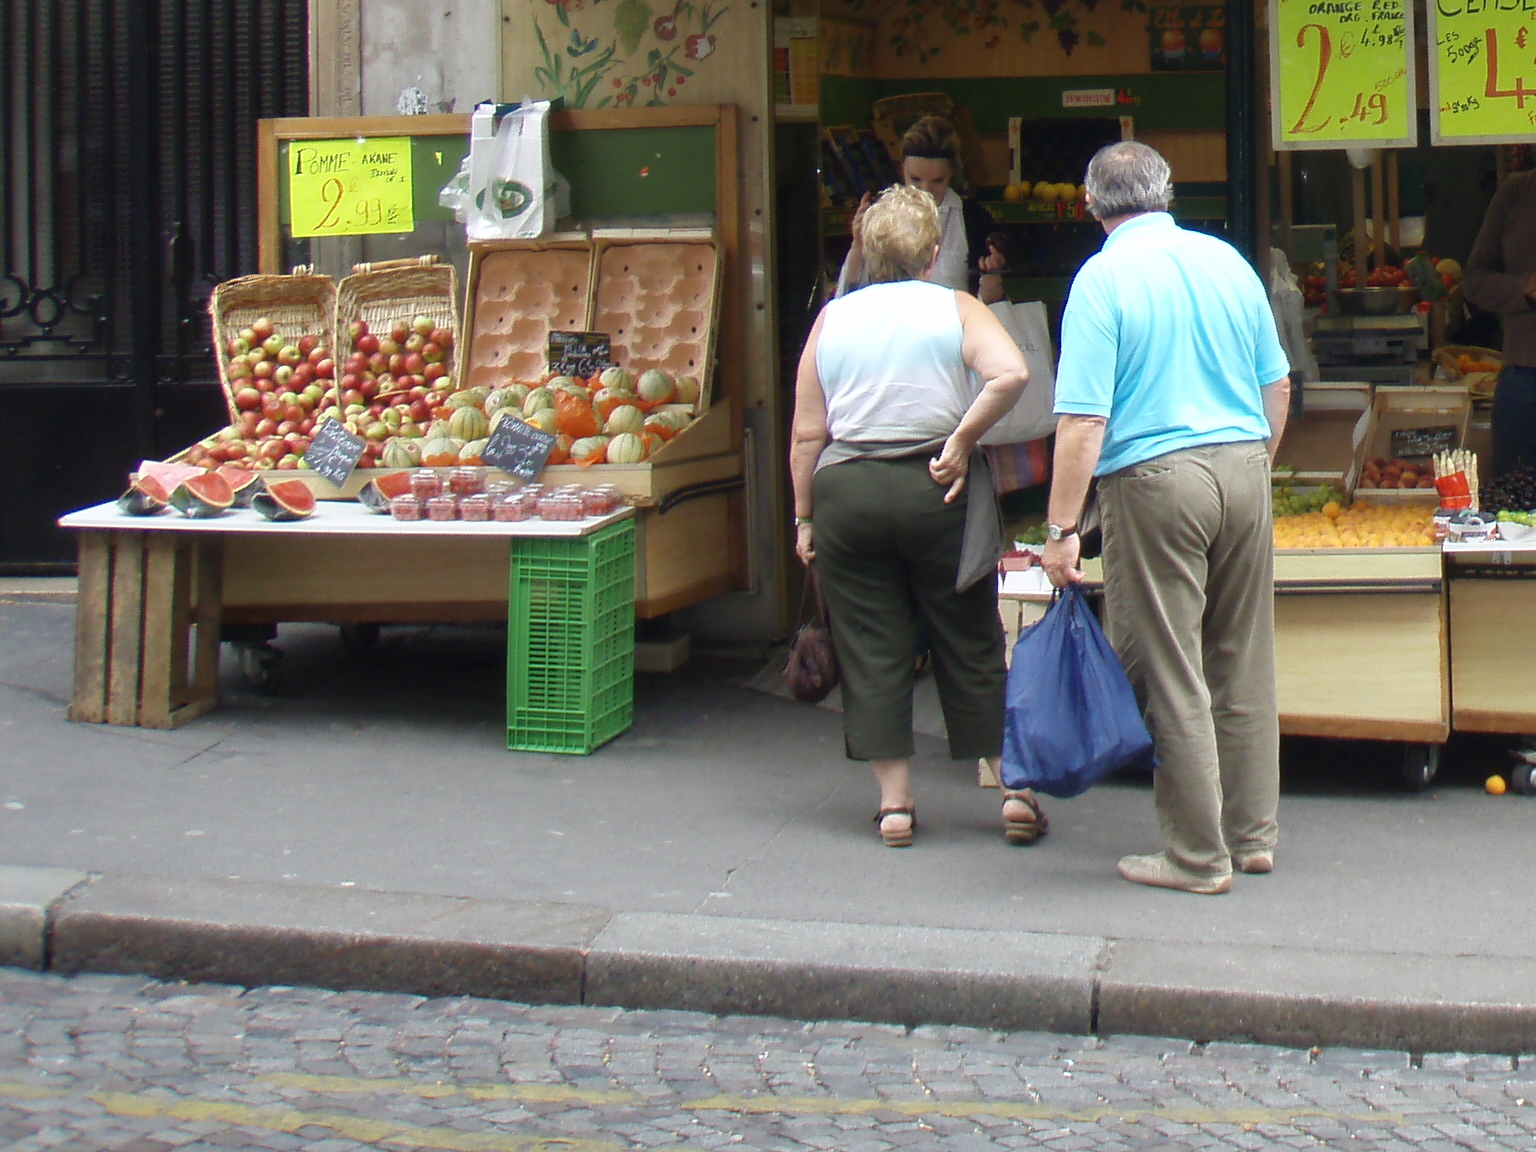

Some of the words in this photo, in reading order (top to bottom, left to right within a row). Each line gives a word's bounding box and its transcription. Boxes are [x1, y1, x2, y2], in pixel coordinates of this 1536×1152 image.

[1309, 1, 1362, 15] ORANGE
[1514, 25, 1529, 49] €
[295, 147, 351, 176] POMME
[361, 152, 398, 165] AKANE
